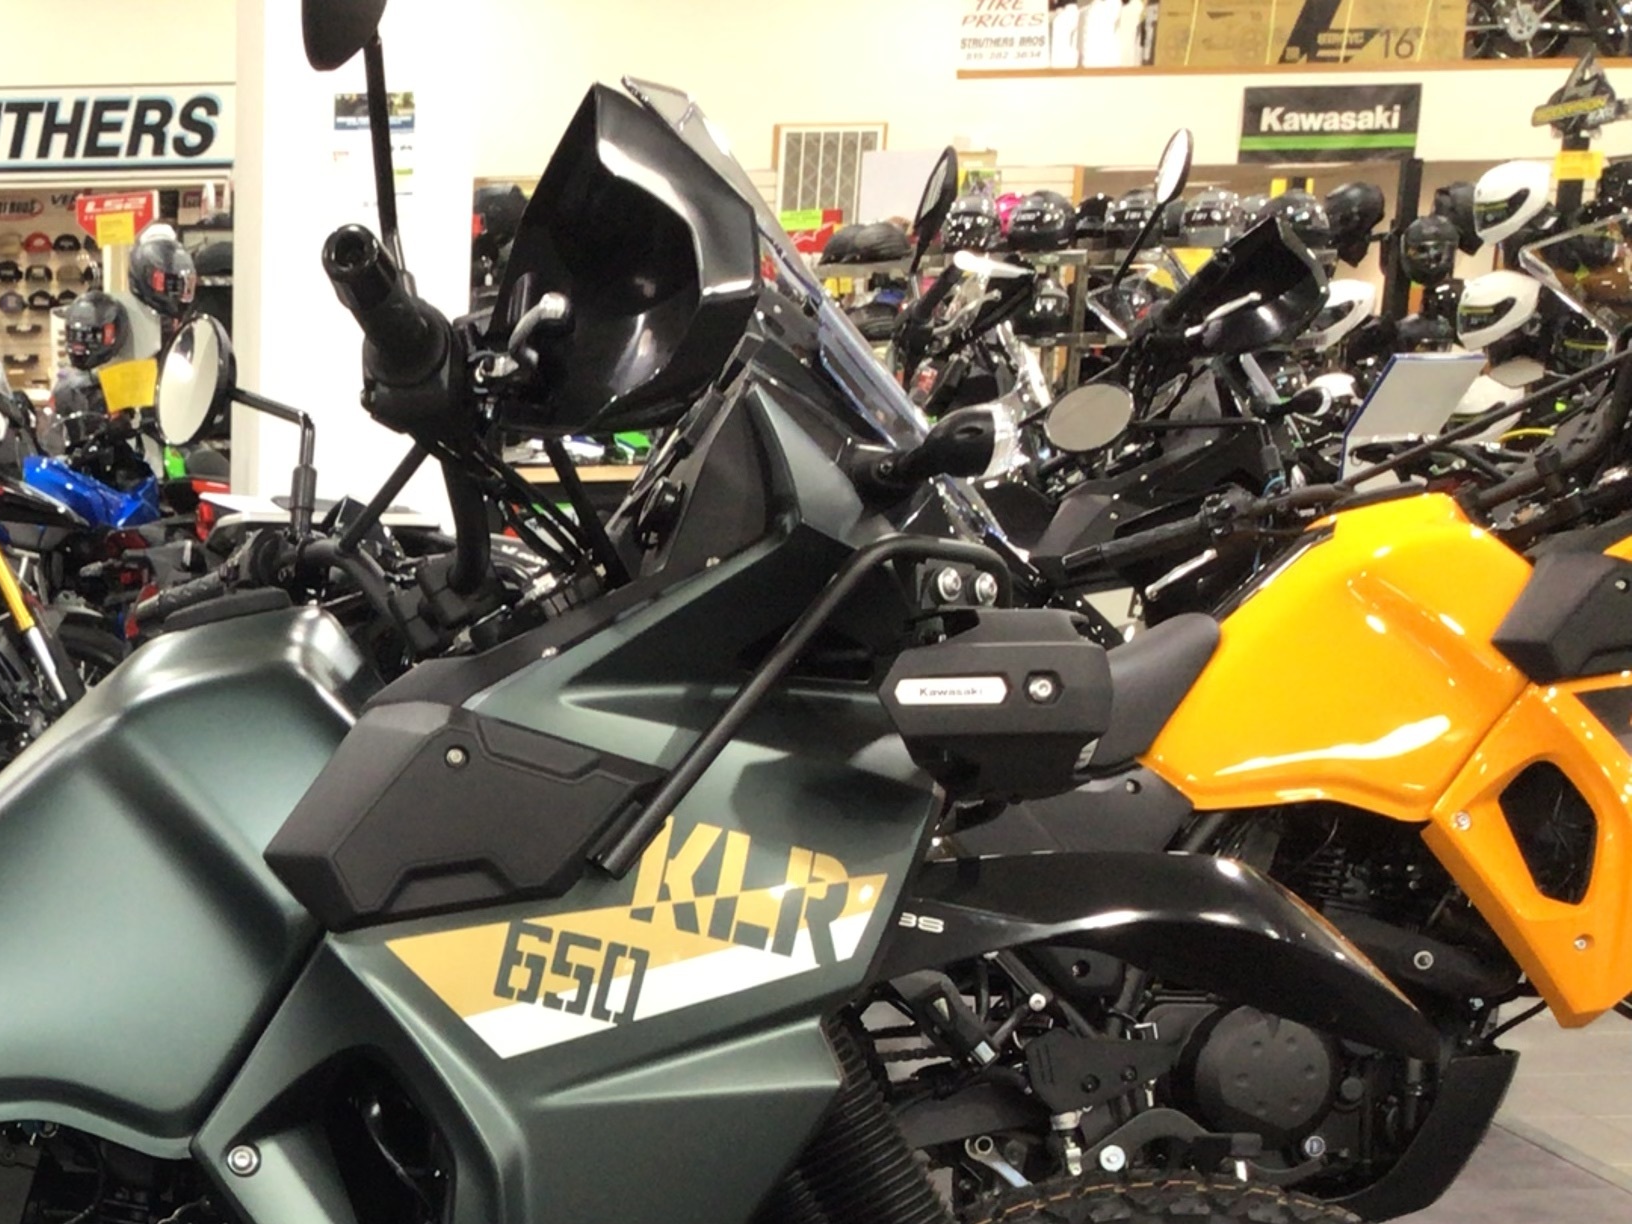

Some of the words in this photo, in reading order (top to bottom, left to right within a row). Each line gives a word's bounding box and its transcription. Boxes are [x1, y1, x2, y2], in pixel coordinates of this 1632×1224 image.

[961, 13, 1045, 28] PRICES
[1379, 28, 1415, 59] 16
[1259, 104, 1401, 132] Kawasaki
[85, 197, 147, 213] LS2
[919, 686, 983, 697] Kawasaki
[629, 815, 850, 964] KLR
[493, 919, 650, 1025] 650
